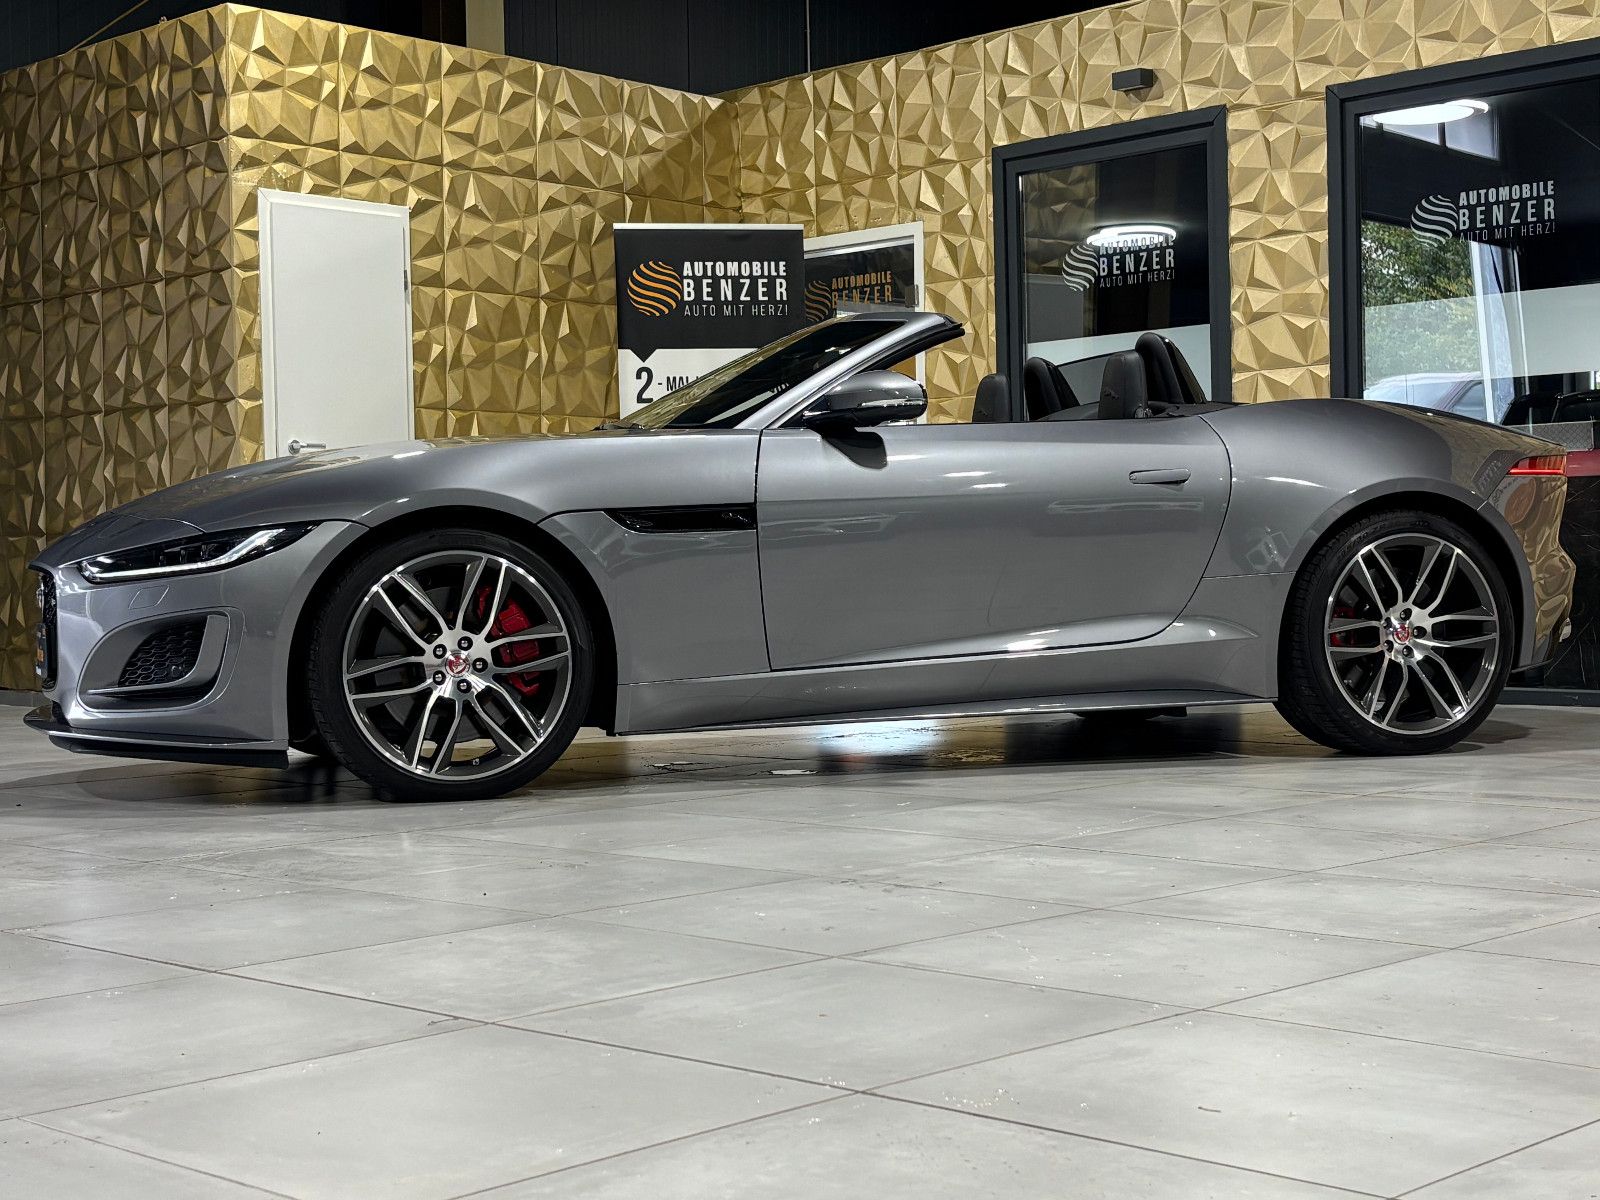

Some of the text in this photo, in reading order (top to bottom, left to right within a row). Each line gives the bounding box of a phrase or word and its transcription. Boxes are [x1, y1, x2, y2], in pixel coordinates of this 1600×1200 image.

[1459, 180, 1555, 207] AUTOMOBILE
[1459, 198, 1555, 230] BENZER
[1100, 234, 1174, 255] AUTOMOBILE
[1460, 228, 1488, 243] AUTO
[1494, 226, 1514, 240] MIT
[683, 261, 787, 277] AUTOMOBILE
[1100, 248, 1174, 276] BENZER
[683, 278, 788, 302] BENZER
[831, 270, 892, 290] AUTOMOBILE
[1100, 276, 1123, 288] AUTO
[1127, 273, 1143, 285] MIT
[831, 284, 892, 309] BENZER
[684, 304, 716, 317] AUTO
[723, 304, 744, 317] MIT
